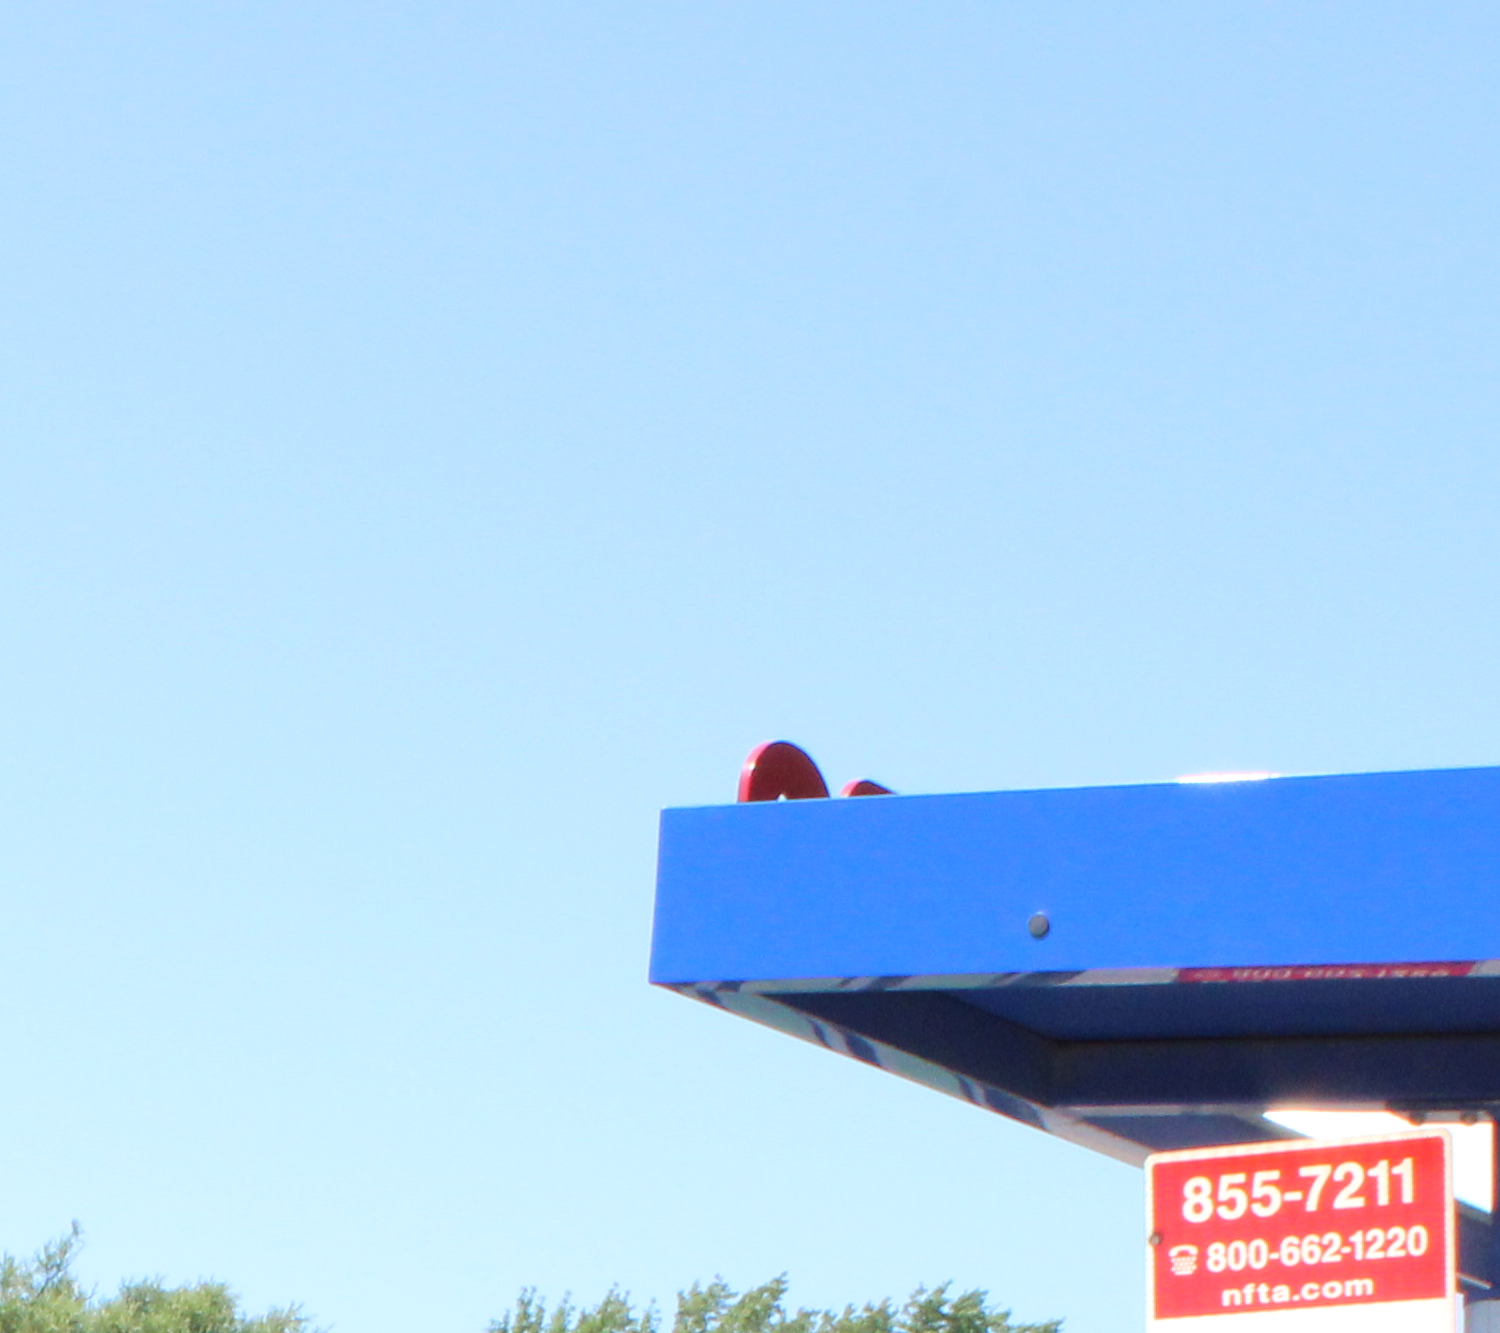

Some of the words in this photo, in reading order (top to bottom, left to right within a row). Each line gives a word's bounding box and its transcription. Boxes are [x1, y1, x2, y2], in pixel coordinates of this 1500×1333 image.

[1181, 1158, 1414, 1223] 855-7211
[1206, 1226, 1428, 1272] 800-662-1220
[1222, 1277, 1374, 1306] nfta.com
